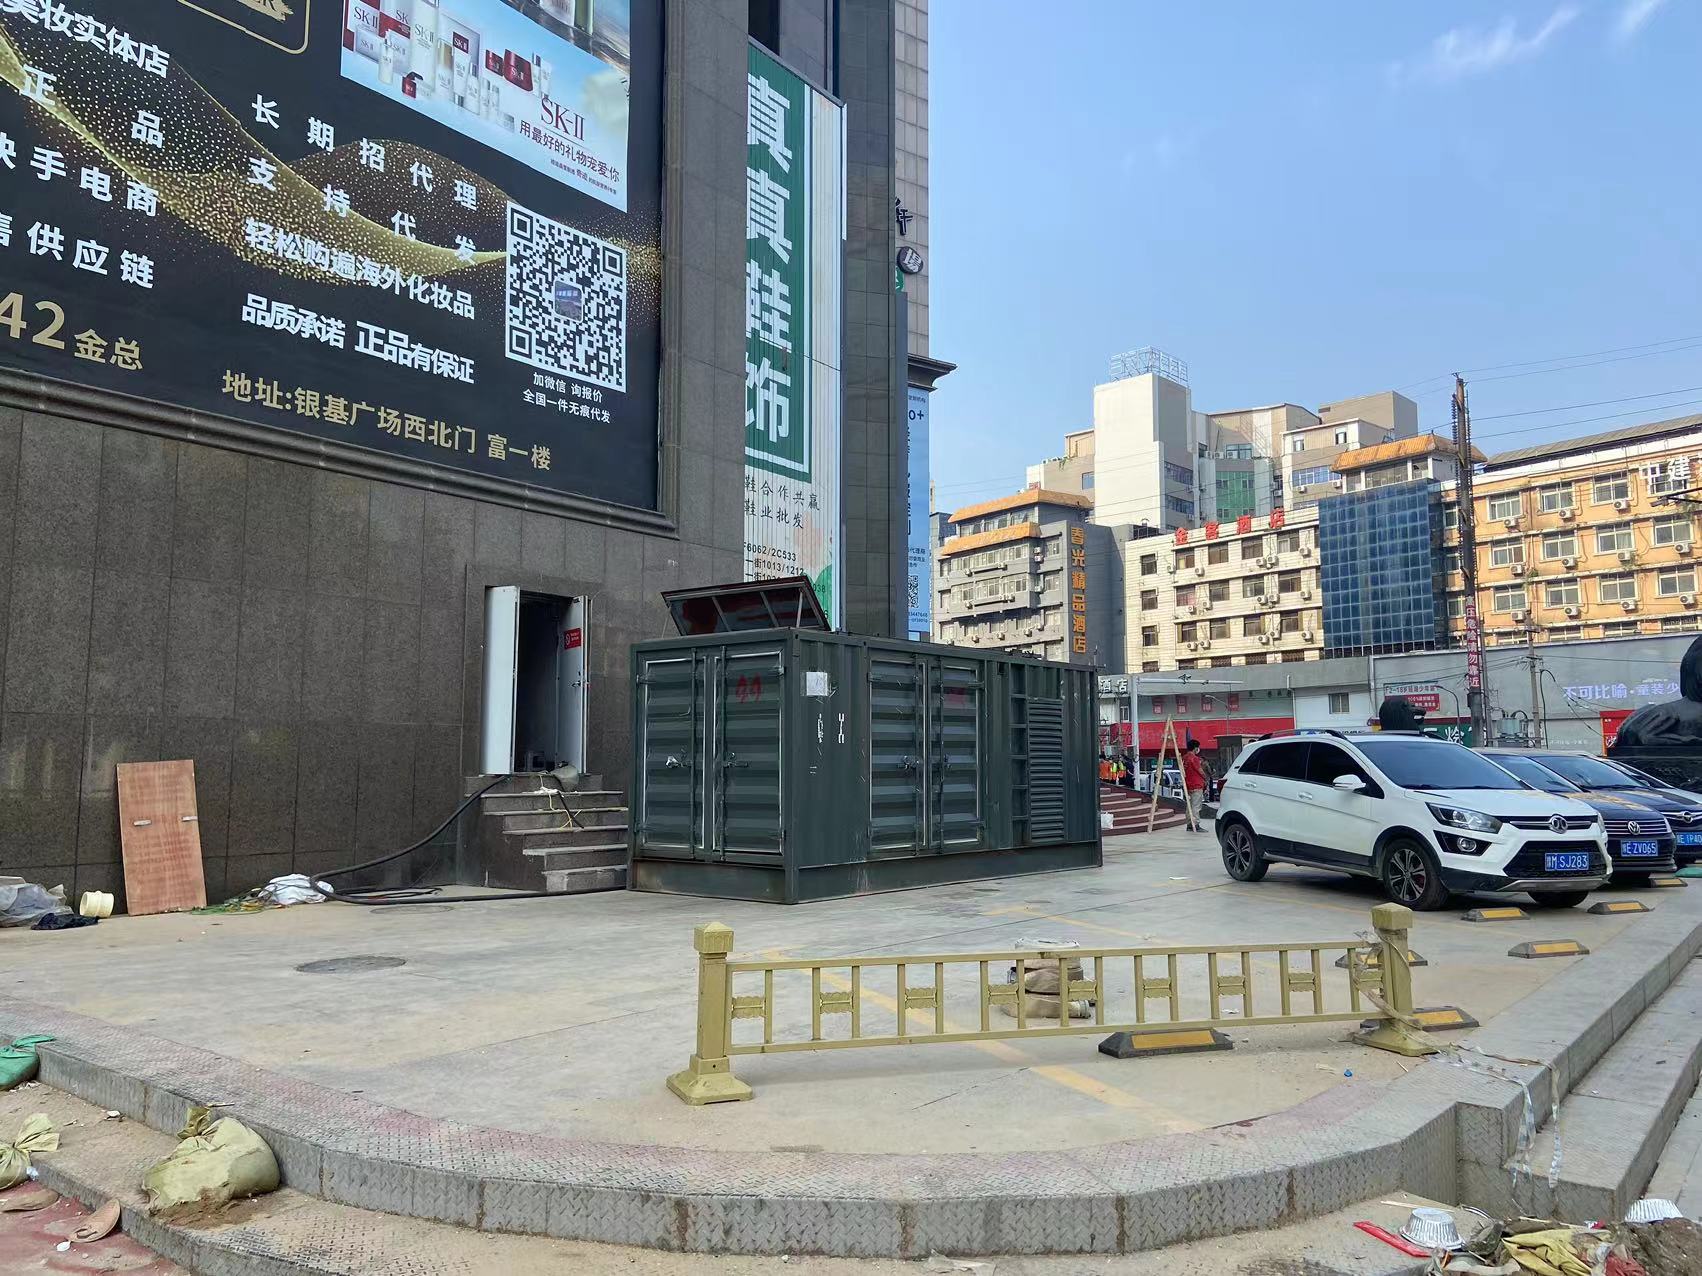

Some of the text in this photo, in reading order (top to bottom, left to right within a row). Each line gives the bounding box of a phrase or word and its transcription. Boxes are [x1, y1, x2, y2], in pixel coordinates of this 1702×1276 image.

[541, 97, 586, 142] SK-II
[252, 94, 477, 212] 长期招代理
[520, 119, 620, 183] 用最好的礼物宠爱你
[249, 157, 477, 266] 支持代发
[245, 216, 476, 320] 轻松购遍海外化妆品
[241, 293, 475, 384] 品质承诺 正品有保证
[523, 388, 611, 424] 全国一件无痕代发
[533, 372, 603, 404] 加微信 询报价
[487, 433, 551, 471] 富一楼
[744, 498, 804, 530] 鞋业批发
